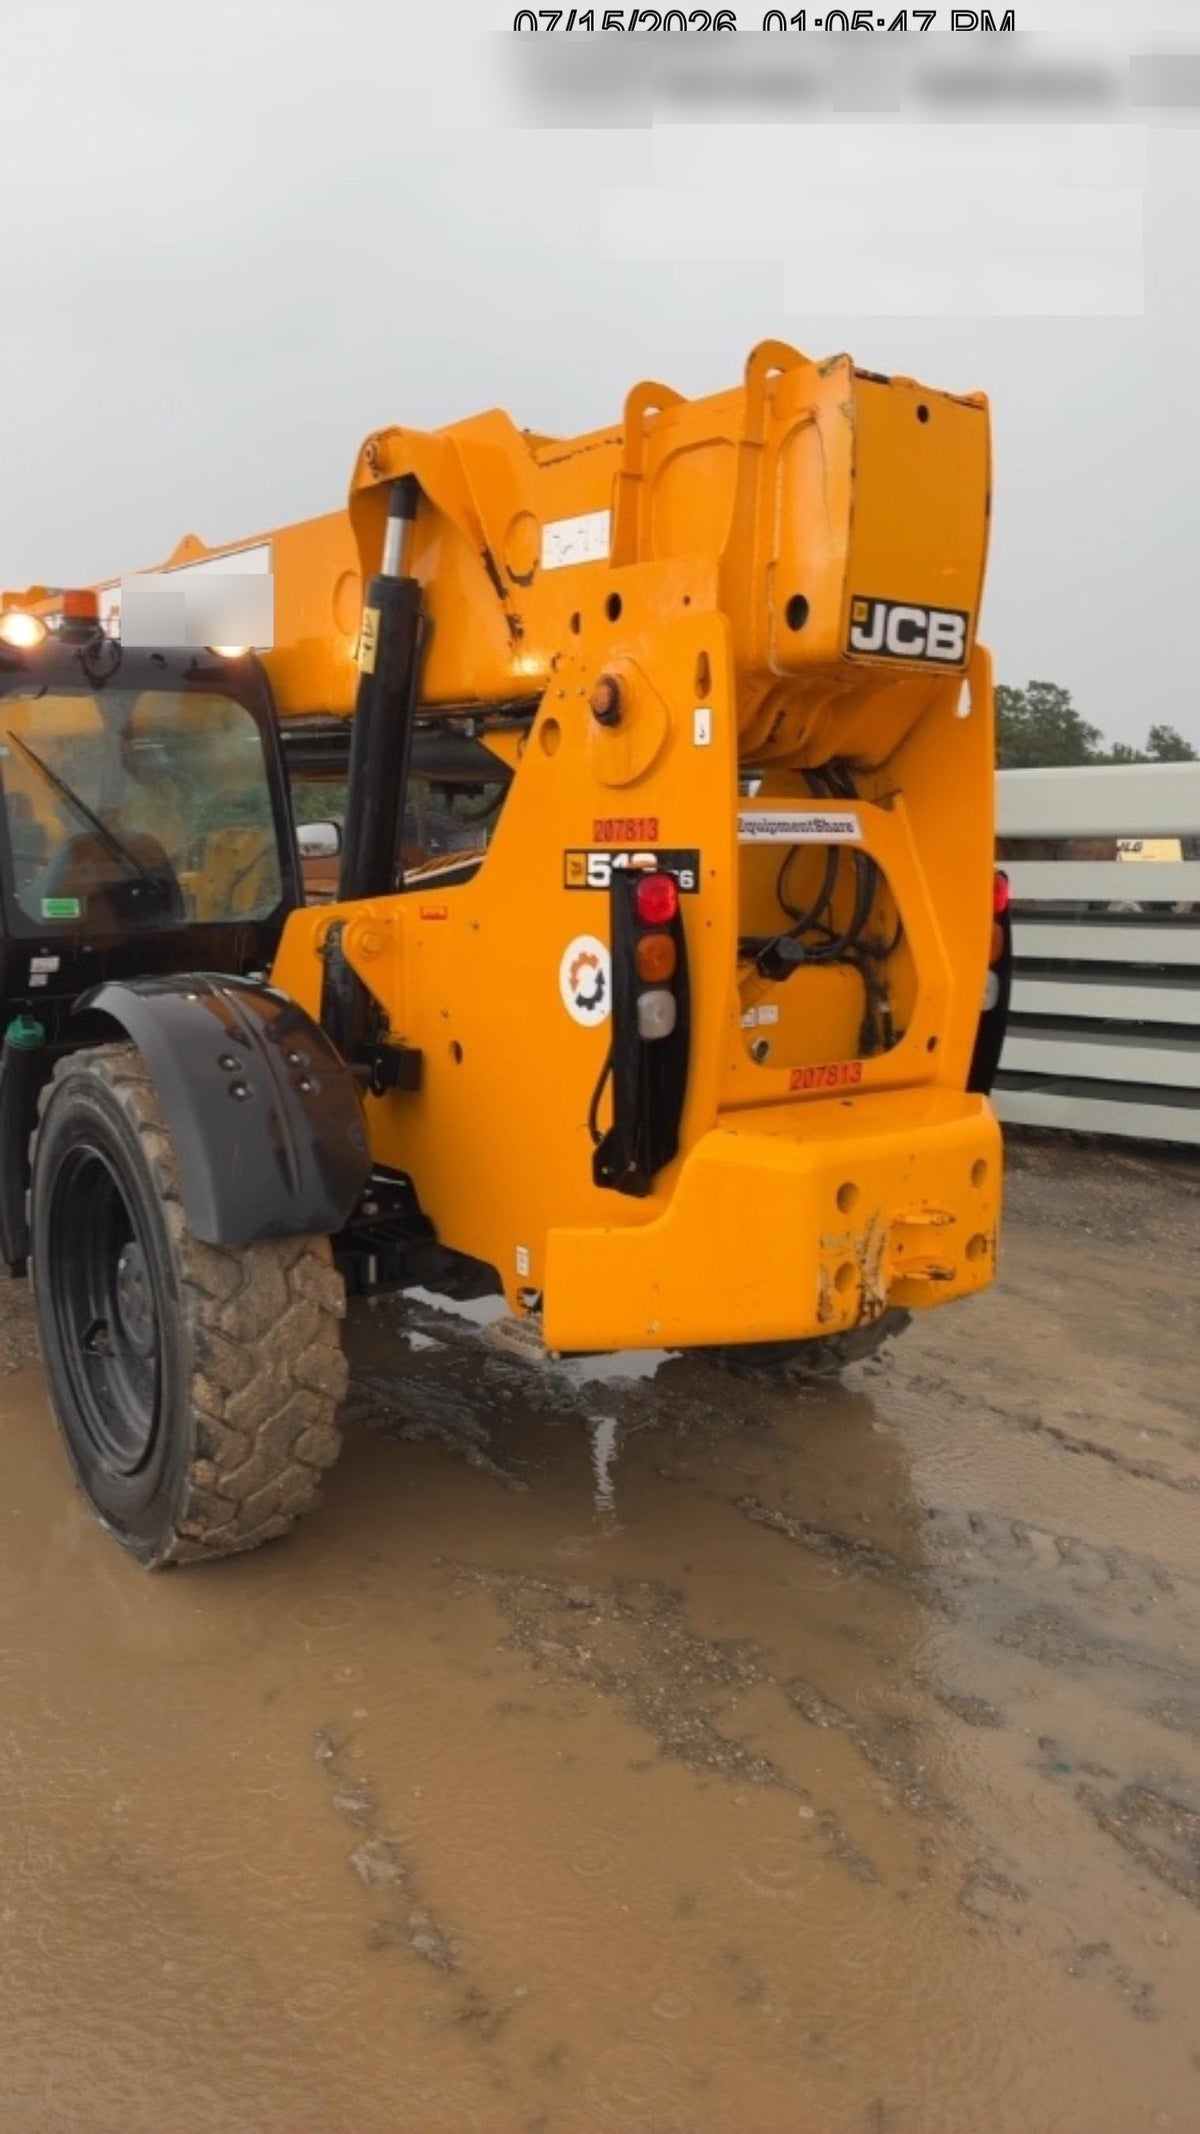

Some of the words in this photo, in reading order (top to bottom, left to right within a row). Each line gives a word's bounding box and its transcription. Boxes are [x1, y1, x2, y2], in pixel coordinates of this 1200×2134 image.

[851, 603, 966, 660] JCB
[594, 818, 657, 841] 207813
[789, 1062, 861, 1091] 207813
